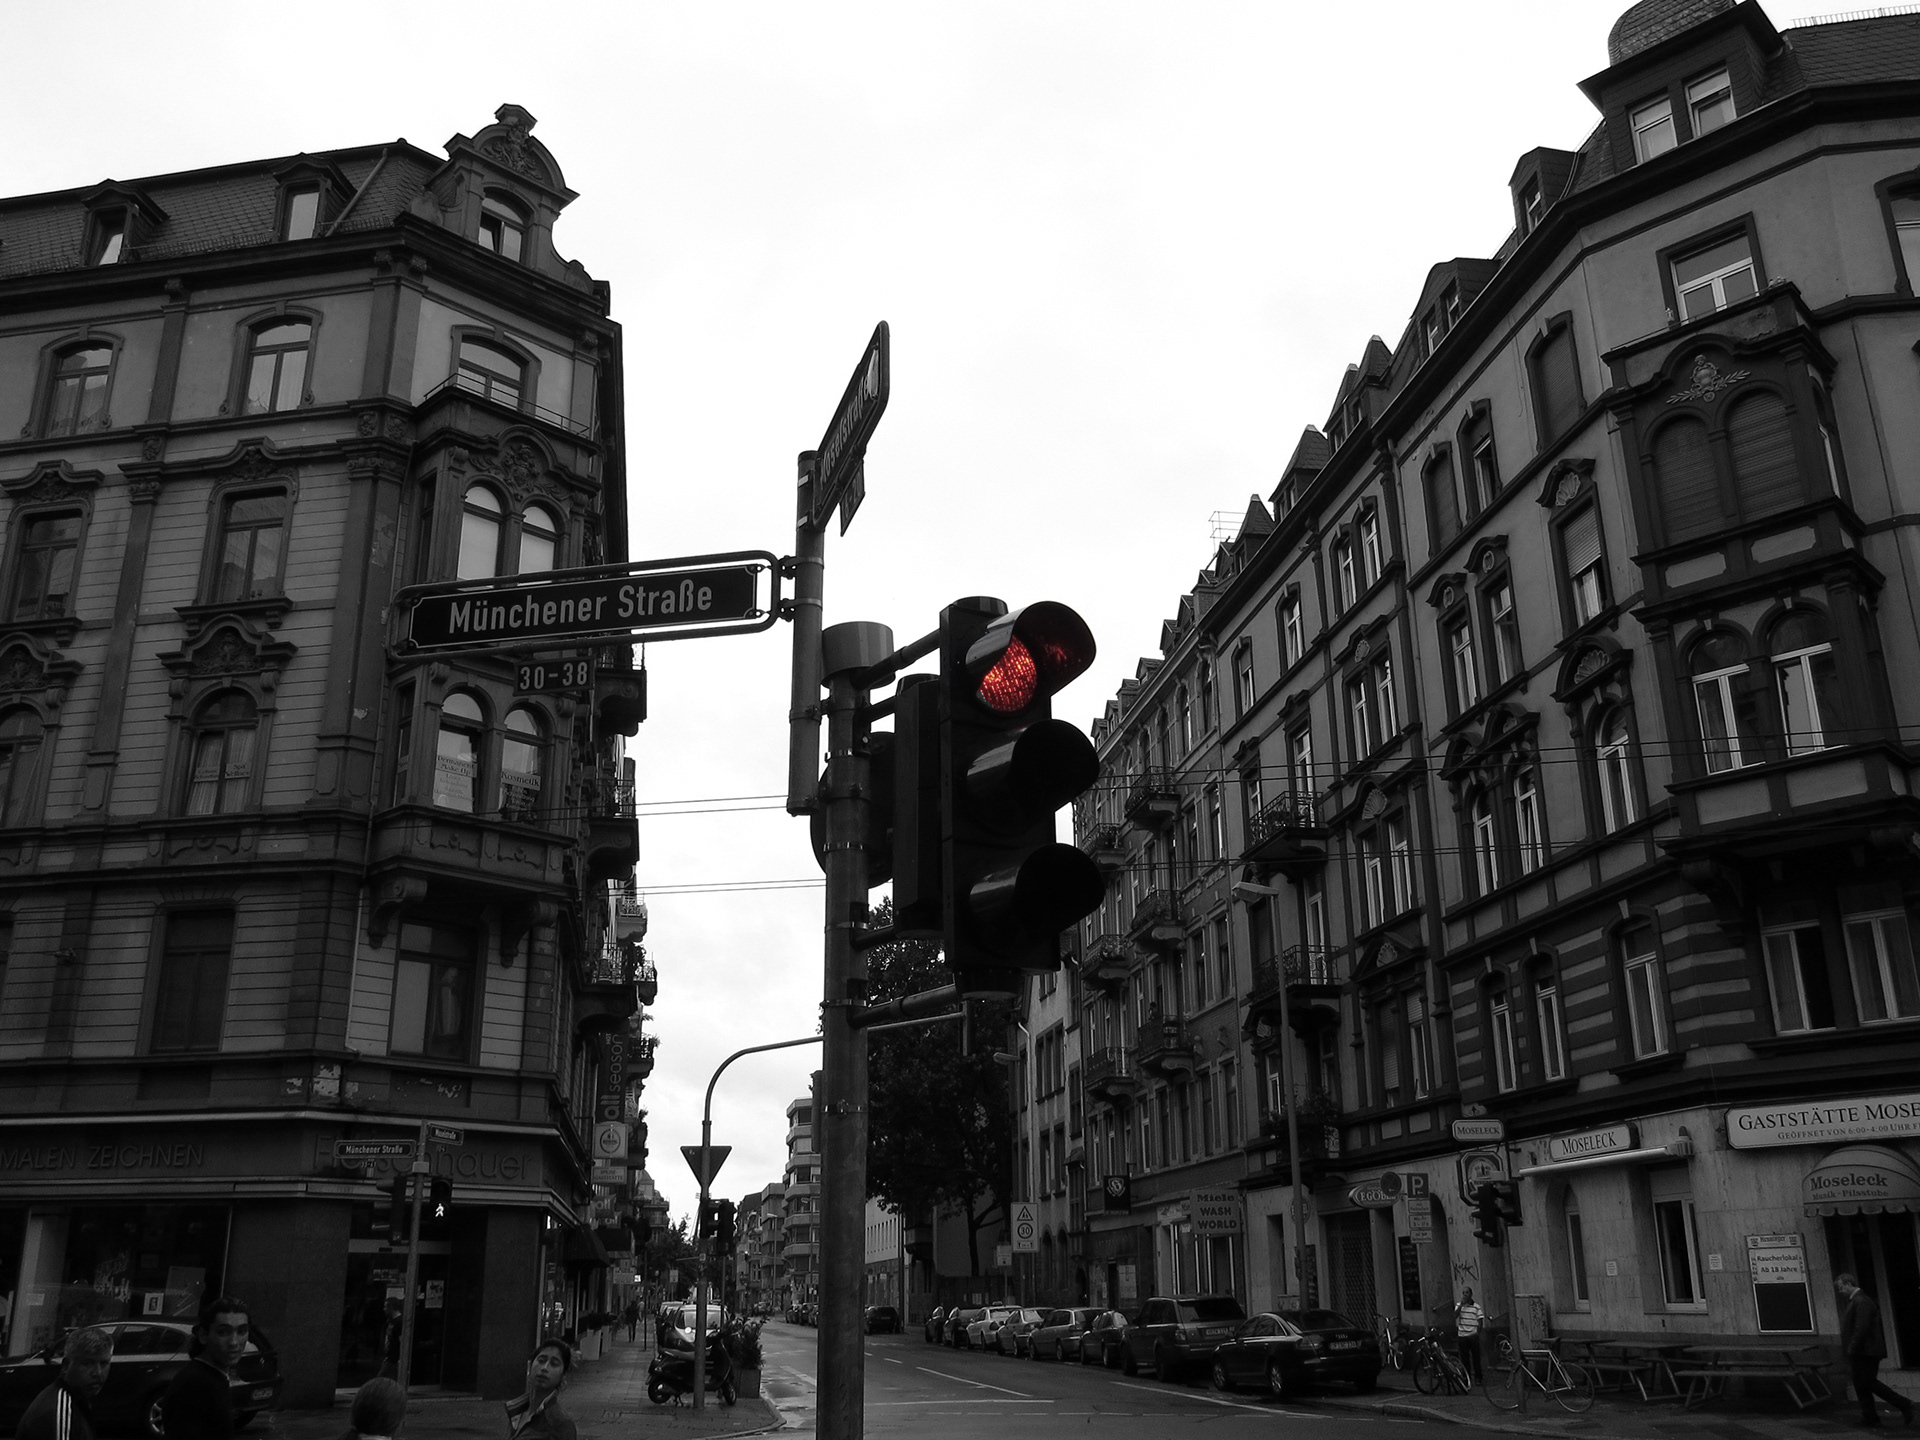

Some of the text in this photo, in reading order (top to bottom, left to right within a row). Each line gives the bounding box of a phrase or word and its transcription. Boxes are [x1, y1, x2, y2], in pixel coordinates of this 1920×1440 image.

[449, 578, 713, 634] Münchener Straße
[501, 771, 539, 787] Kosmetik
[1738, 1108, 1860, 1130] GASTSTÄTTE
[1457, 1126, 1500, 1135] MOSELECK
[1777, 1129, 1825, 1140] GEÖFFNET
[1826, 1127, 1846, 1136] VON
[1890, 1123, 1911, 1132] UHR
[345, 1145, 403, 1154] Münchener Straße
[1561, 1132, 1617, 1155] MOSELECK
[0, 1144, 204, 1169] MALEN ZEICHNEN
[1412, 1176, 1423, 1195] P
[1810, 1173, 1888, 1191] Moseleck
[1197, 1194, 1235, 1202] Miele
[1842, 1189, 1888, 1197] Pilsstube
[1200, 1206, 1232, 1216] WASH
[1020, 1226, 1030, 1235] 30
[1197, 1220, 1237, 1229] WORLD
